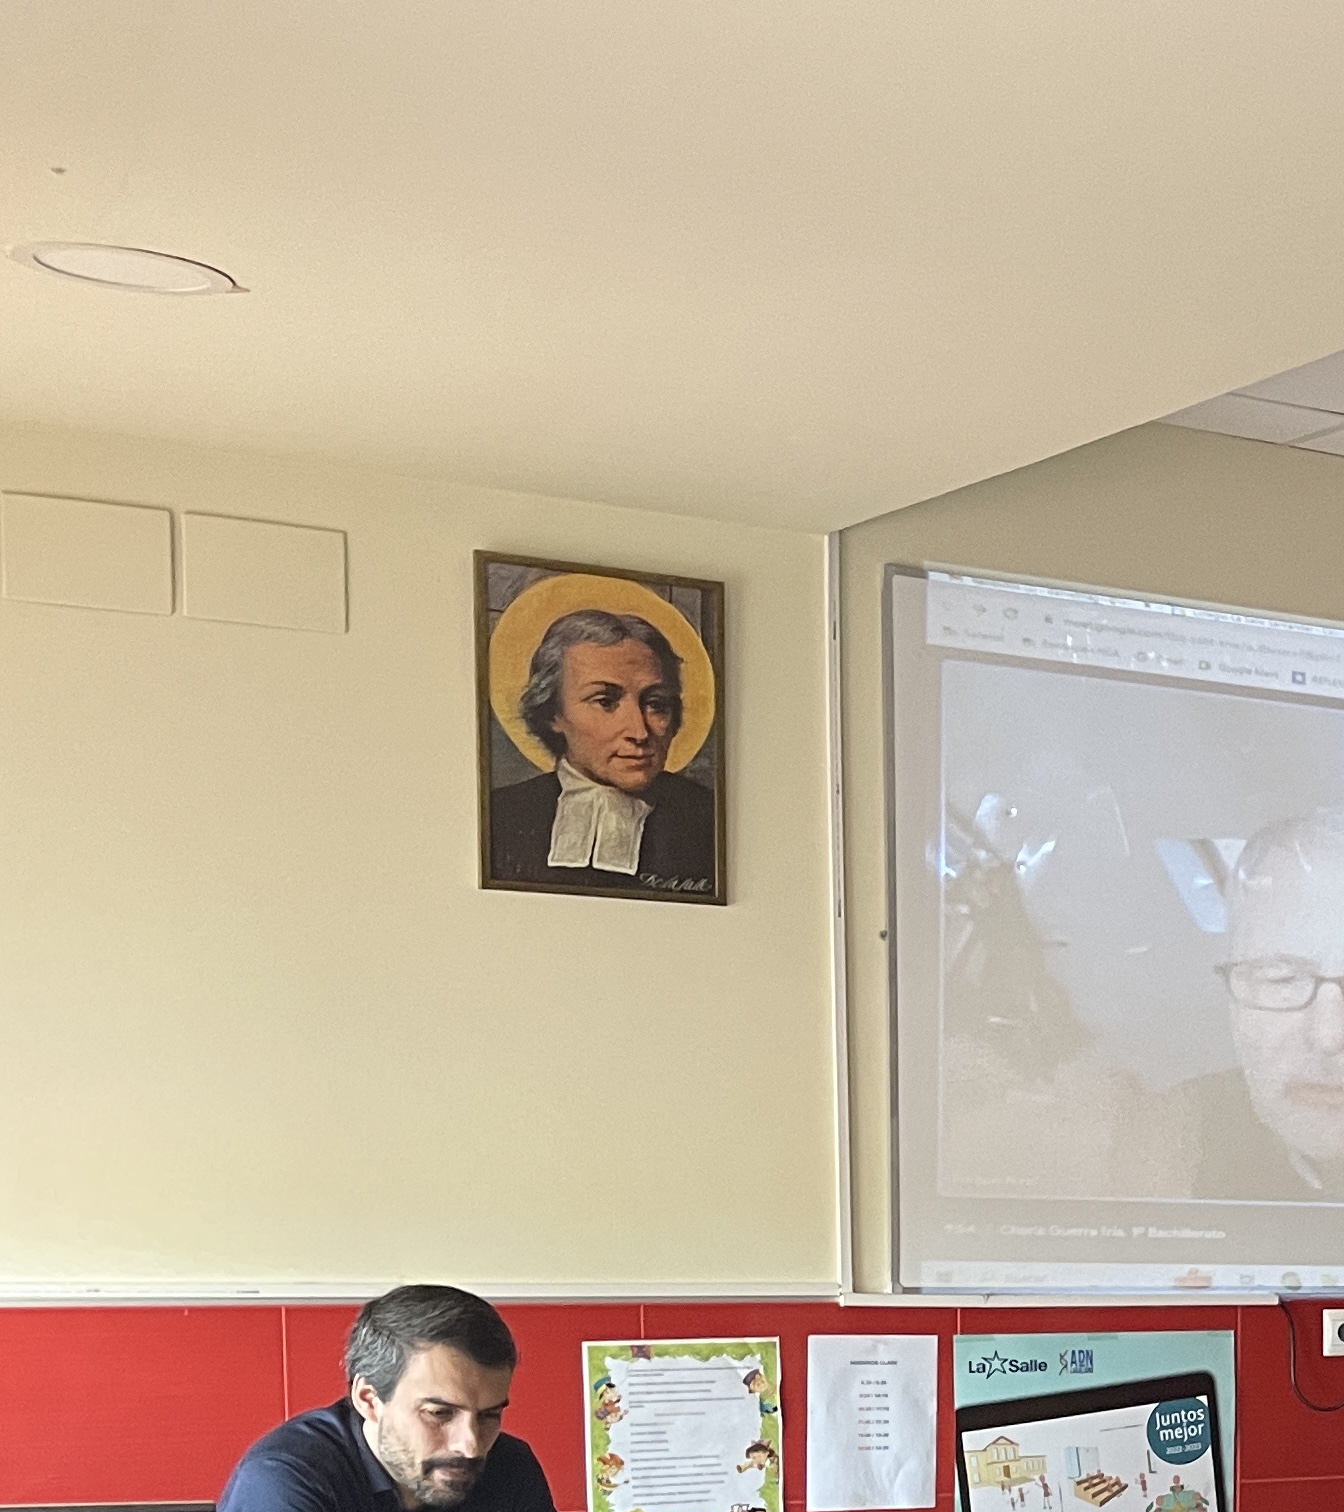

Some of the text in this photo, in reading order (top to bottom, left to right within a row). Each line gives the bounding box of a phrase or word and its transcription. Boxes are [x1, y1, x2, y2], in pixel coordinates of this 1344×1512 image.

[968, 1359, 1048, 1373] La Salle
[1155, 1408, 1205, 1431] Juntos
[1159, 1422, 1205, 1442] mejor
